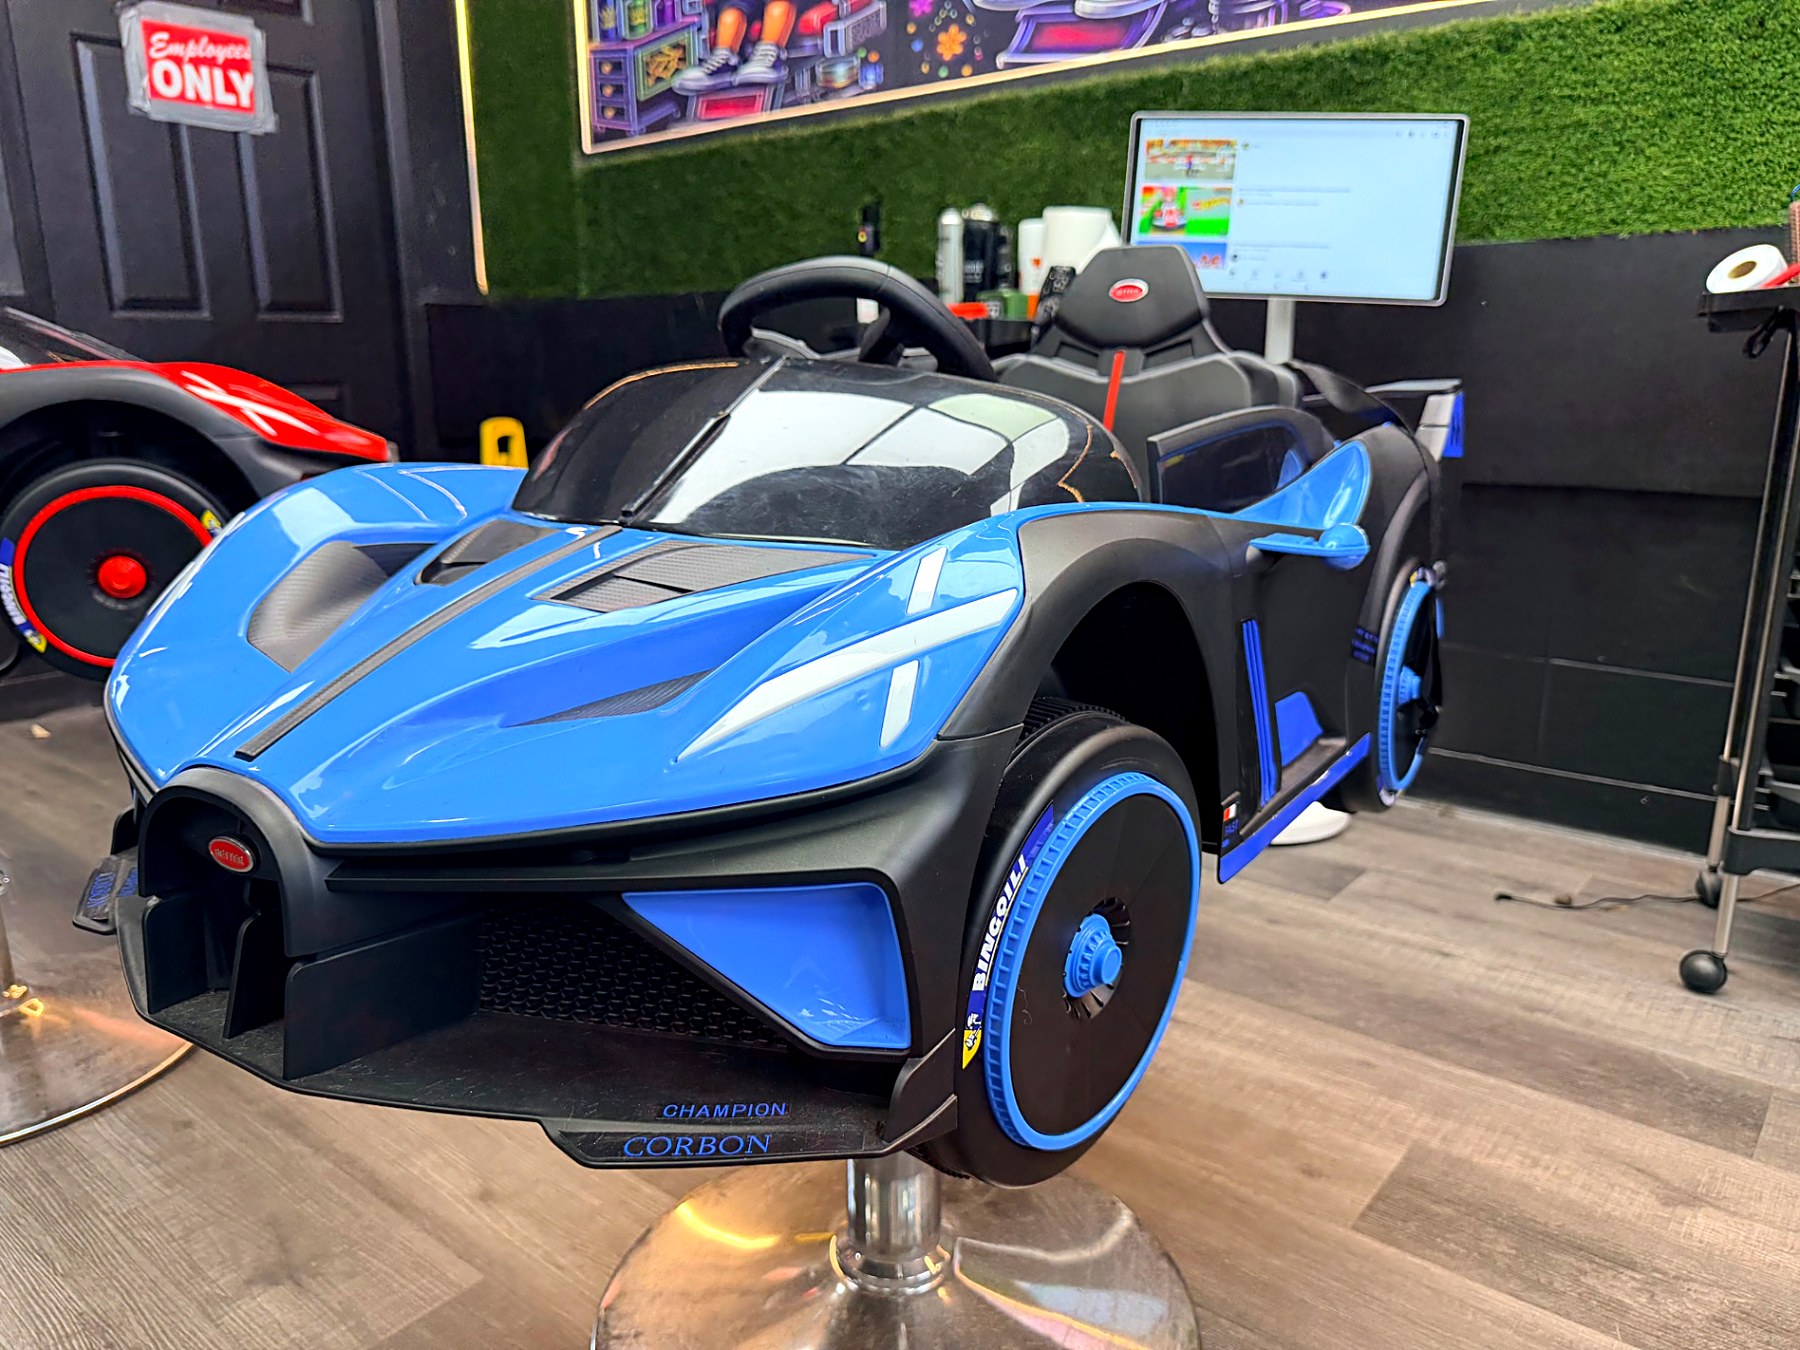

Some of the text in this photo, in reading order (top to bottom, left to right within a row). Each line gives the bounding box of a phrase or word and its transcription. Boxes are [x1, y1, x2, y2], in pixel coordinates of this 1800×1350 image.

[151, 59, 253, 107] ONLY
[662, 1103, 787, 1118] CHAMPION
[623, 1135, 772, 1157] CORBON
